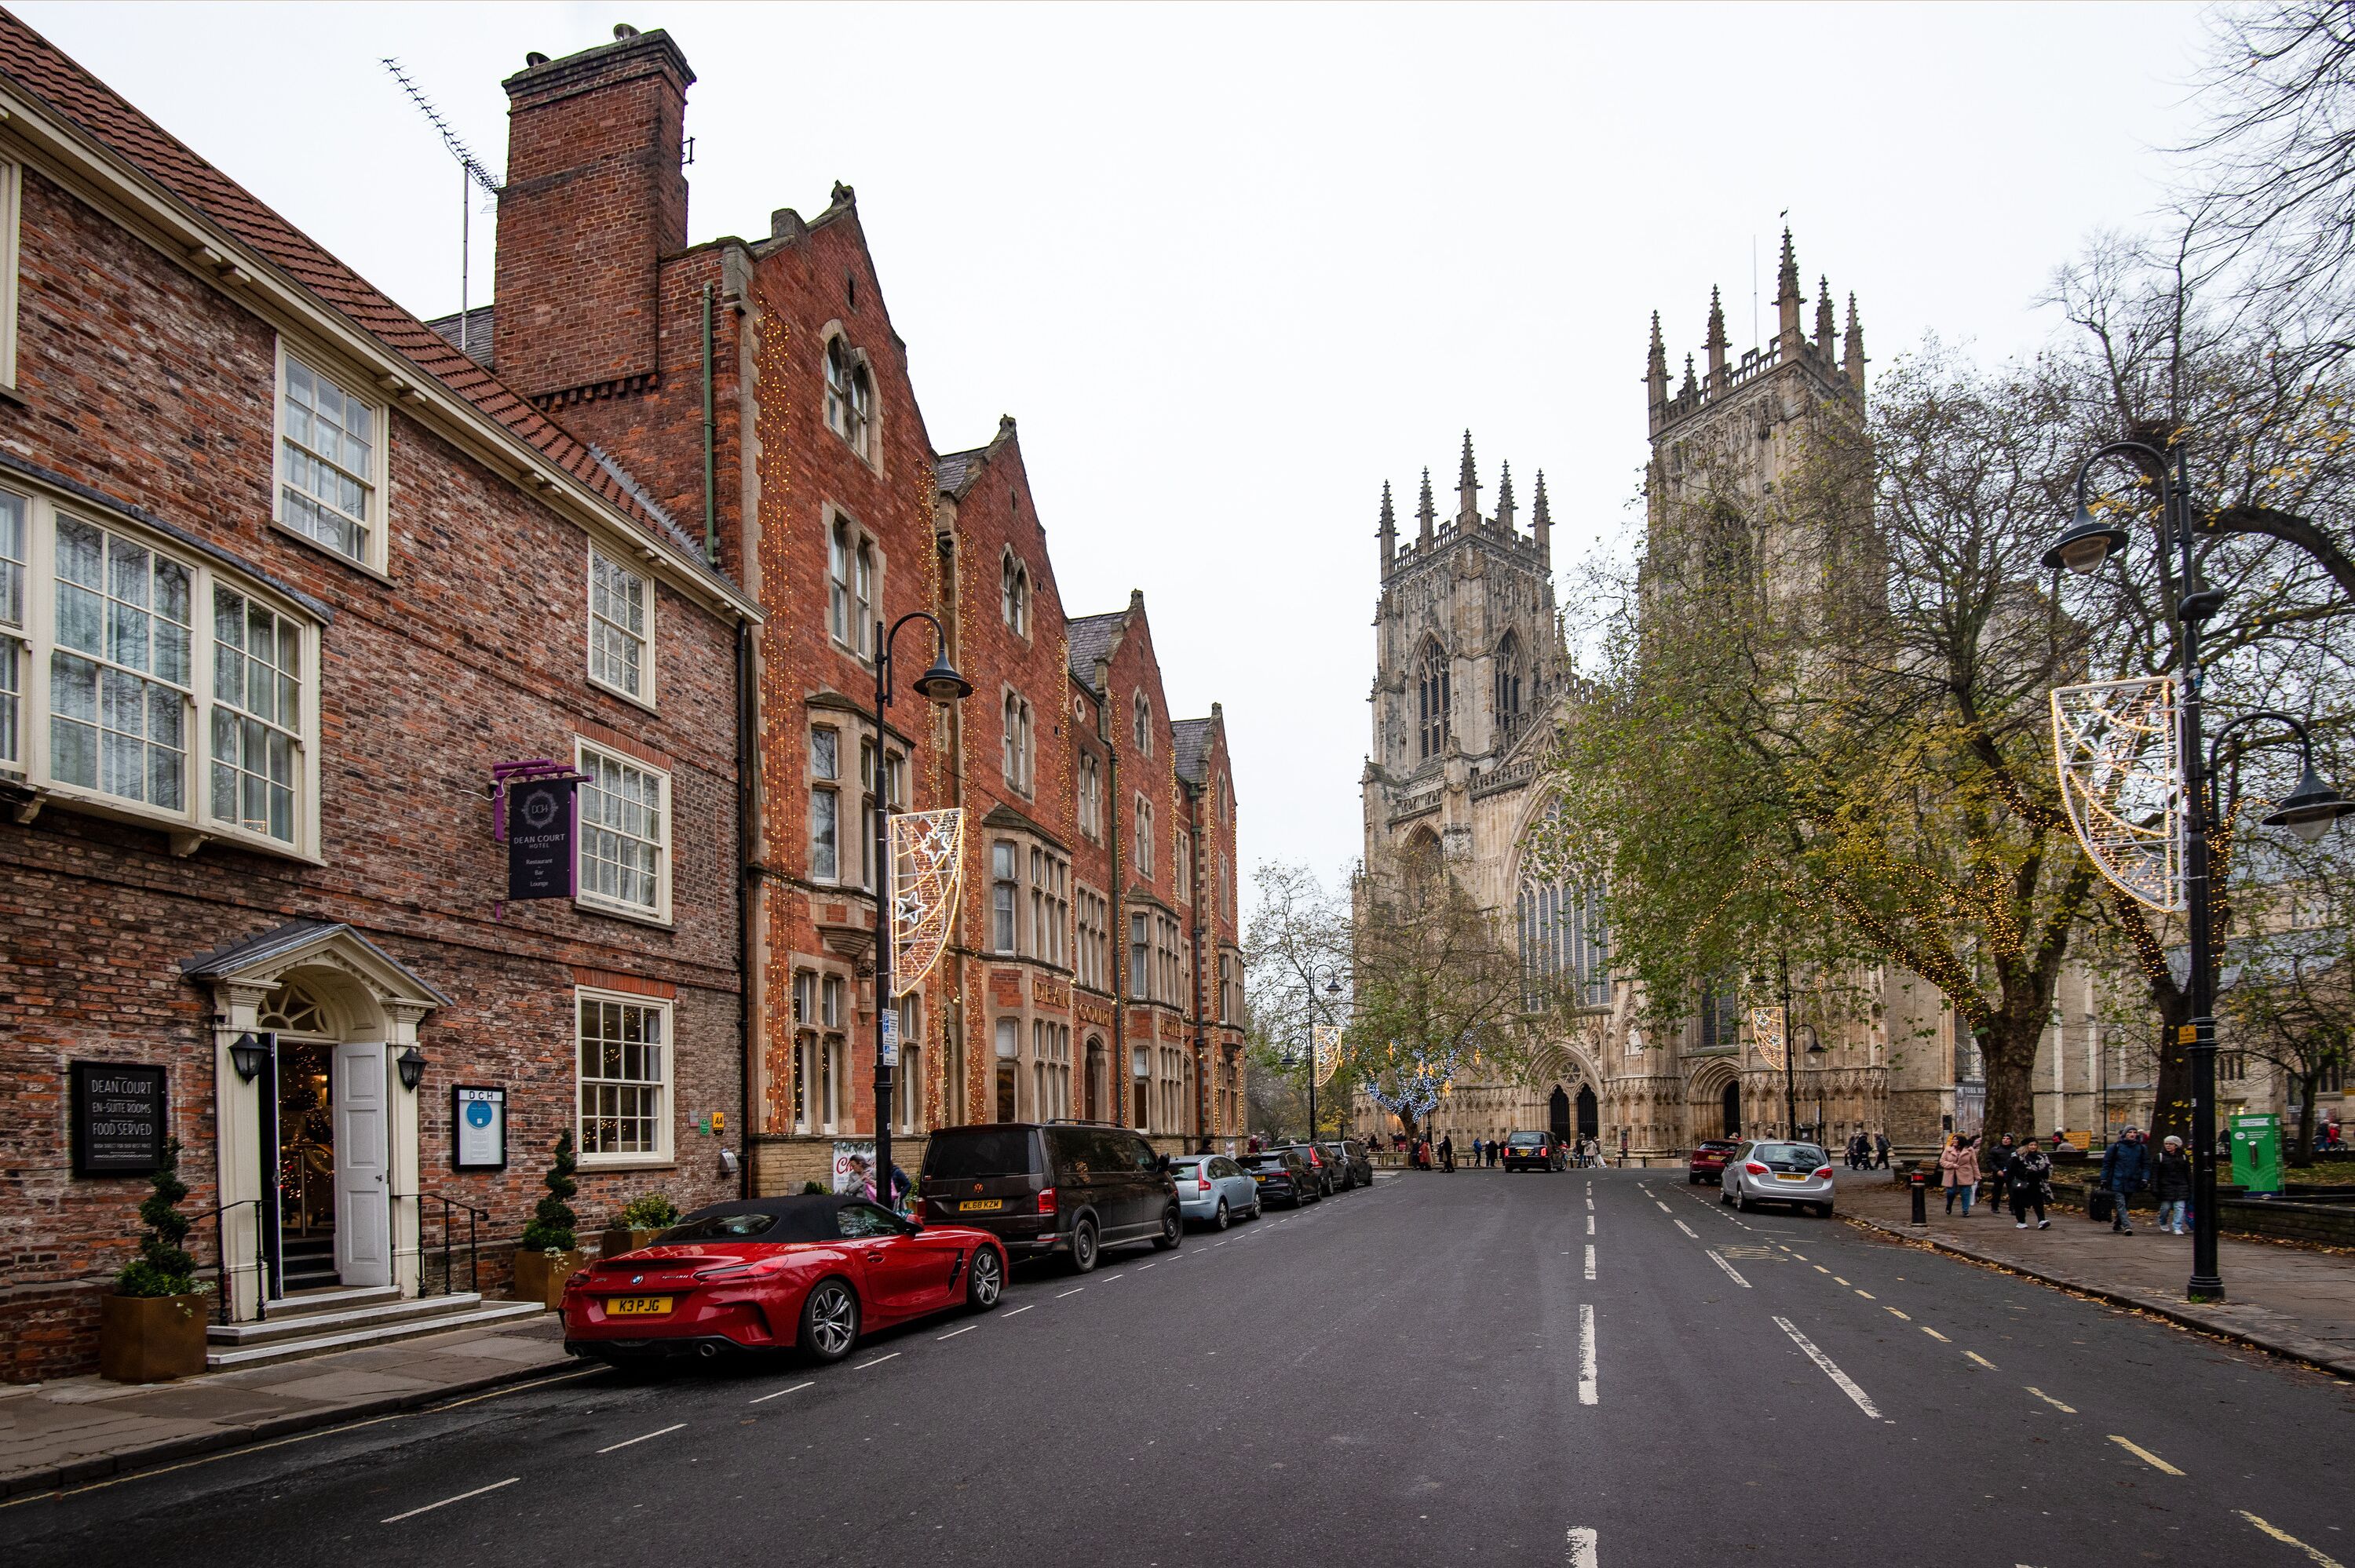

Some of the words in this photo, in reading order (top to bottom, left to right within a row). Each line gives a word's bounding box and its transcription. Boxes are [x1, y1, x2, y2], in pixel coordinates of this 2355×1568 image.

[514, 836, 535, 844] DEAN
[537, 833, 565, 843] COURT
[1034, 980, 1070, 1008] DEAN
[1079, 1002, 1113, 1027] COURT
[91, 1080, 119, 1093] DEAN
[121, 1081, 153, 1095] COURT
[92, 1102, 126, 1113] EN-SUITE
[126, 1103, 152, 1114] ROOMS
[92, 1122, 116, 1136] FOOD
[117, 1123, 152, 1136] SERVED
[619, 1300, 634, 1311] K3
[636, 1299, 660, 1311] PJG
